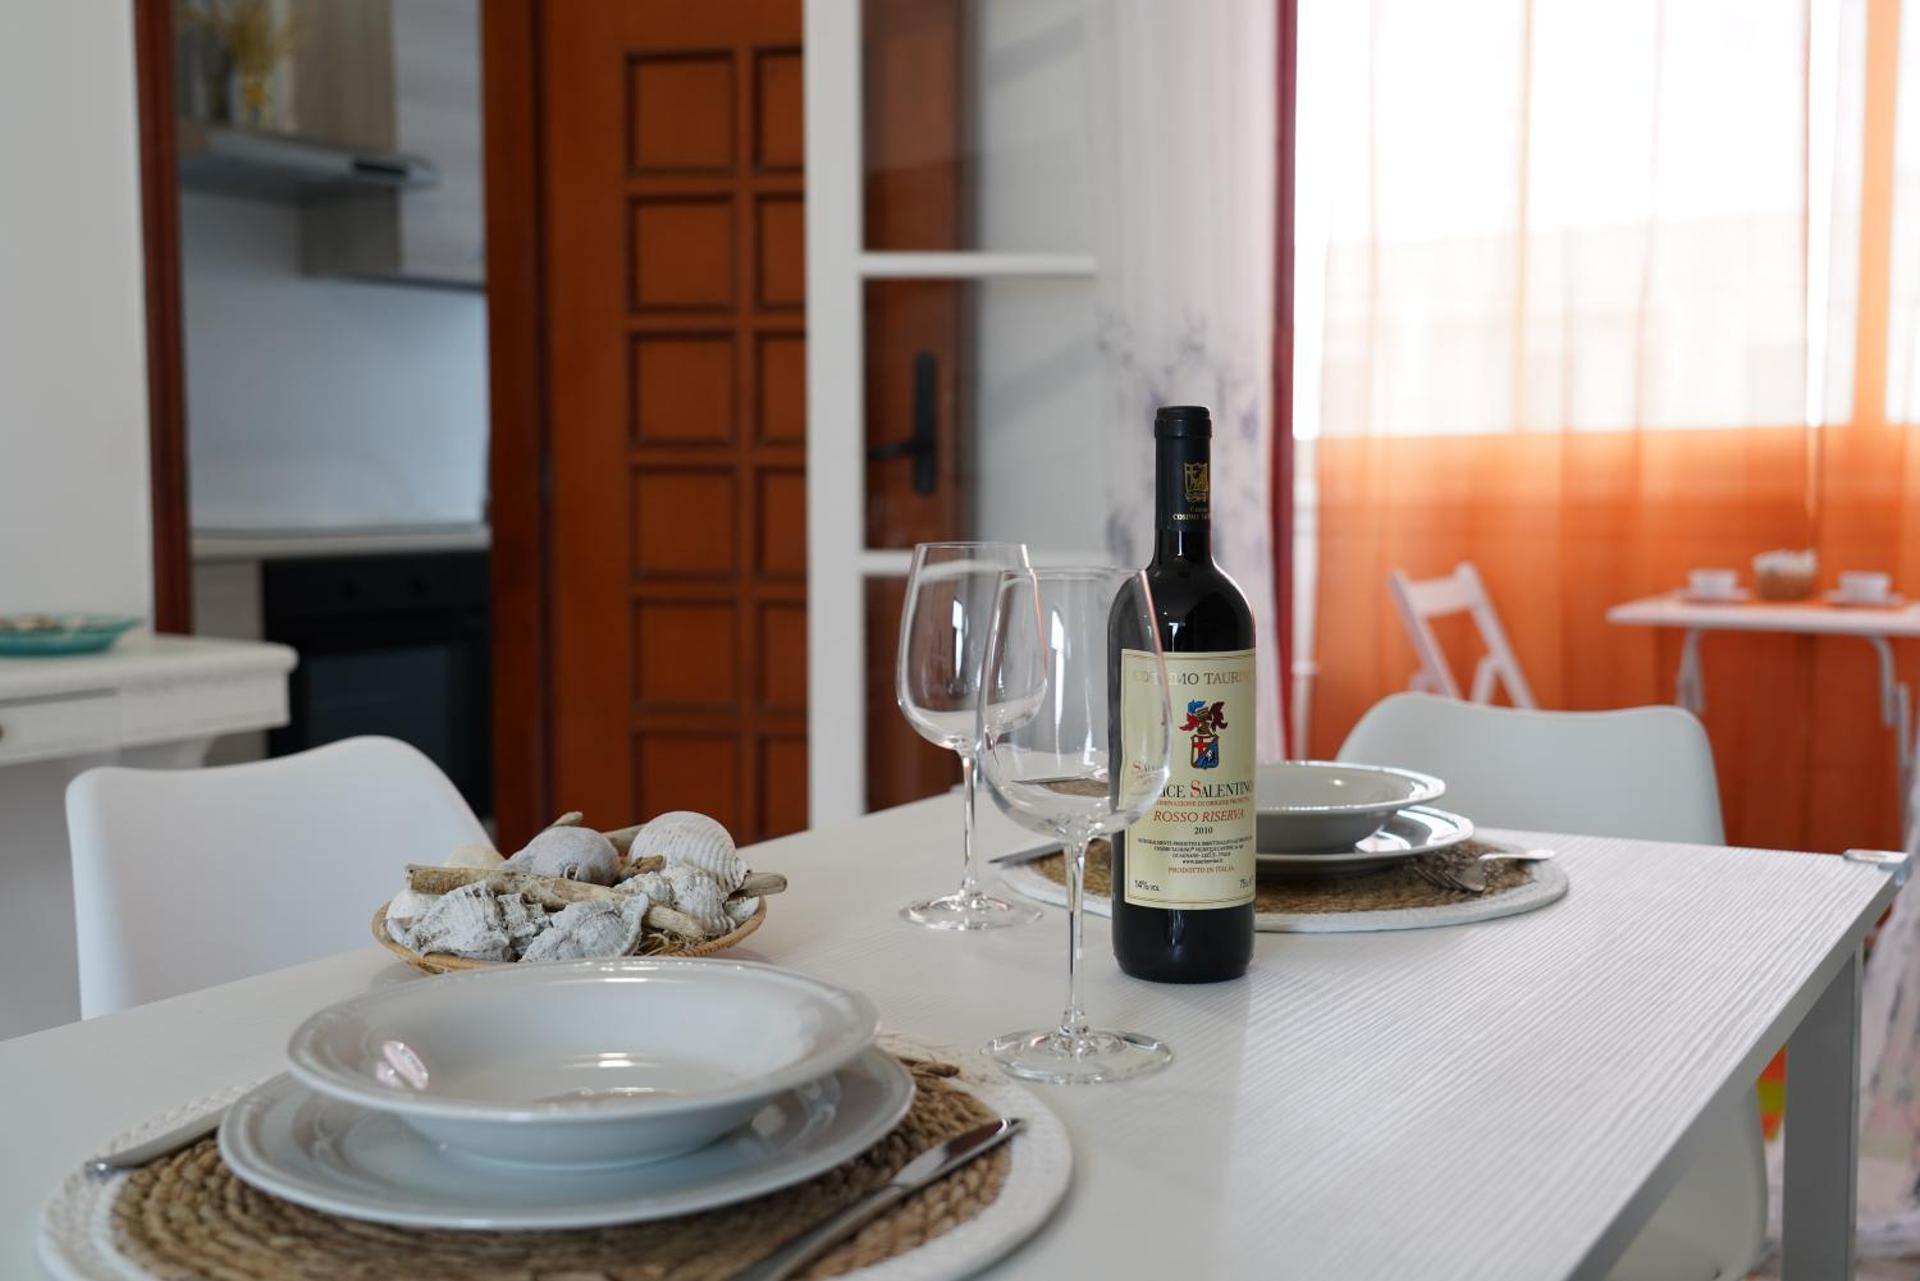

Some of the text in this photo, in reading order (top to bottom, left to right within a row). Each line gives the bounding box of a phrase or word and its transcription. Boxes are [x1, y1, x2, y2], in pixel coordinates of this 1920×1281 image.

[1153, 808, 1246, 823] ROSSO RISERVA
[1194, 826, 1213, 835] 2010
